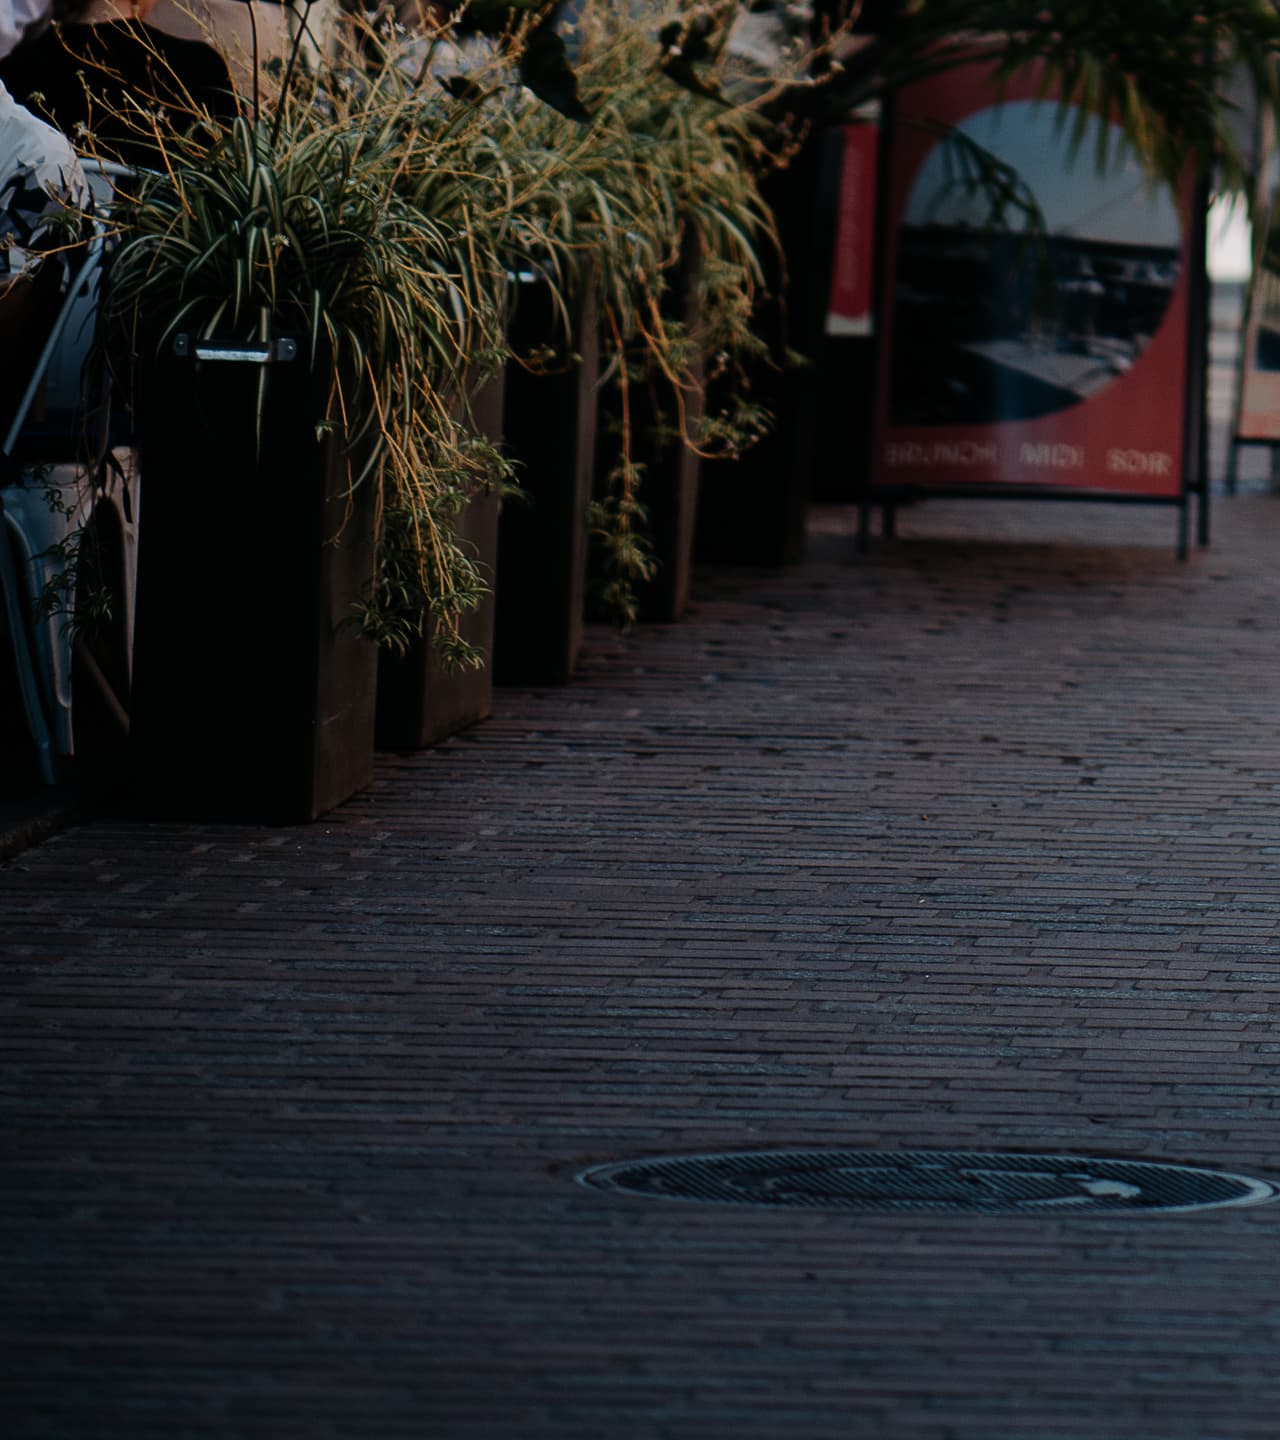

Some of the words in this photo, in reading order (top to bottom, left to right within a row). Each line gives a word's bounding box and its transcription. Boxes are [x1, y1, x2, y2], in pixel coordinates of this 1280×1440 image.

[884, 441, 998, 466] BRUNCH
[1019, 442, 1085, 469] MIDI
[1105, 447, 1172, 475] SOIR
